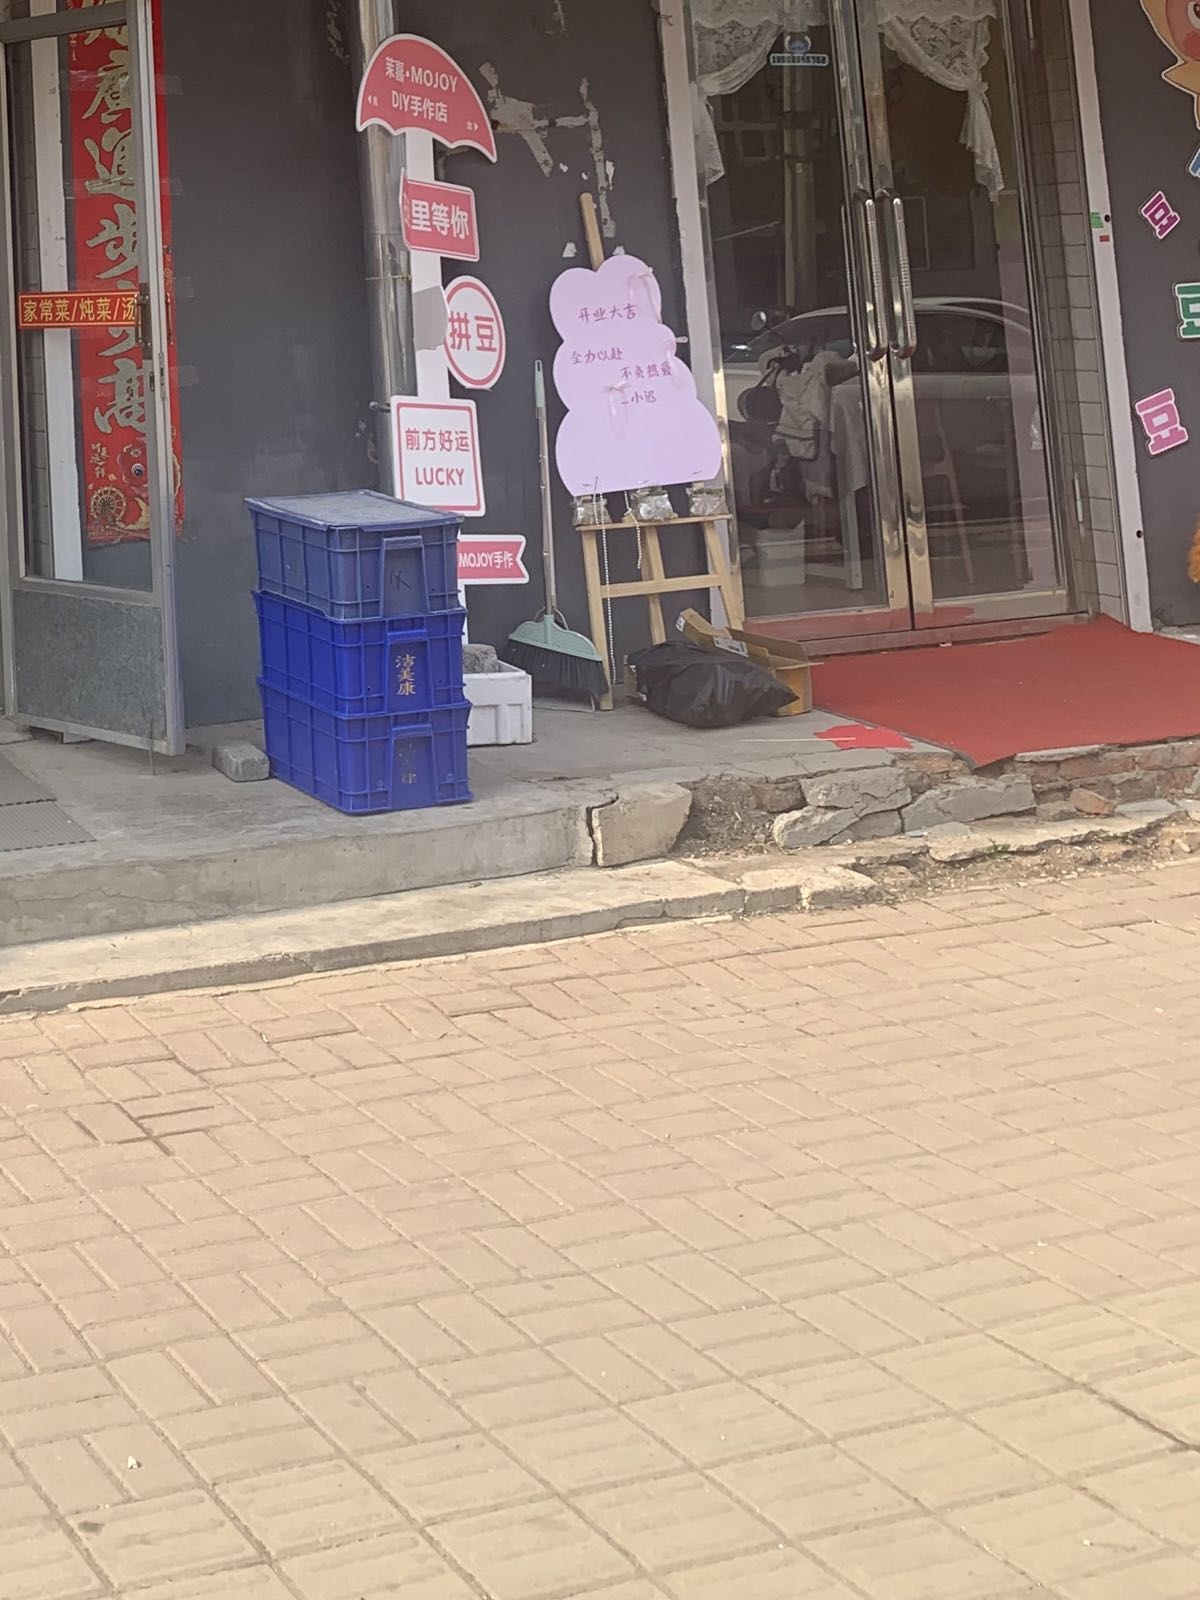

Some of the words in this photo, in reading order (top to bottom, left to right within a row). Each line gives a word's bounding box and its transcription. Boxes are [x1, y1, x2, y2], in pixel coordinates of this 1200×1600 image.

[391, 89, 448, 124] DIY手作店
[578, 303, 637, 322] 开业大吉
[448, 310, 497, 353] 拼豆
[571, 346, 623, 365] 全力以赴
[404, 427, 470, 453] 前方好运
[415, 466, 465, 487] LUCKY
[458, 550, 514, 569] MOJOY手作
